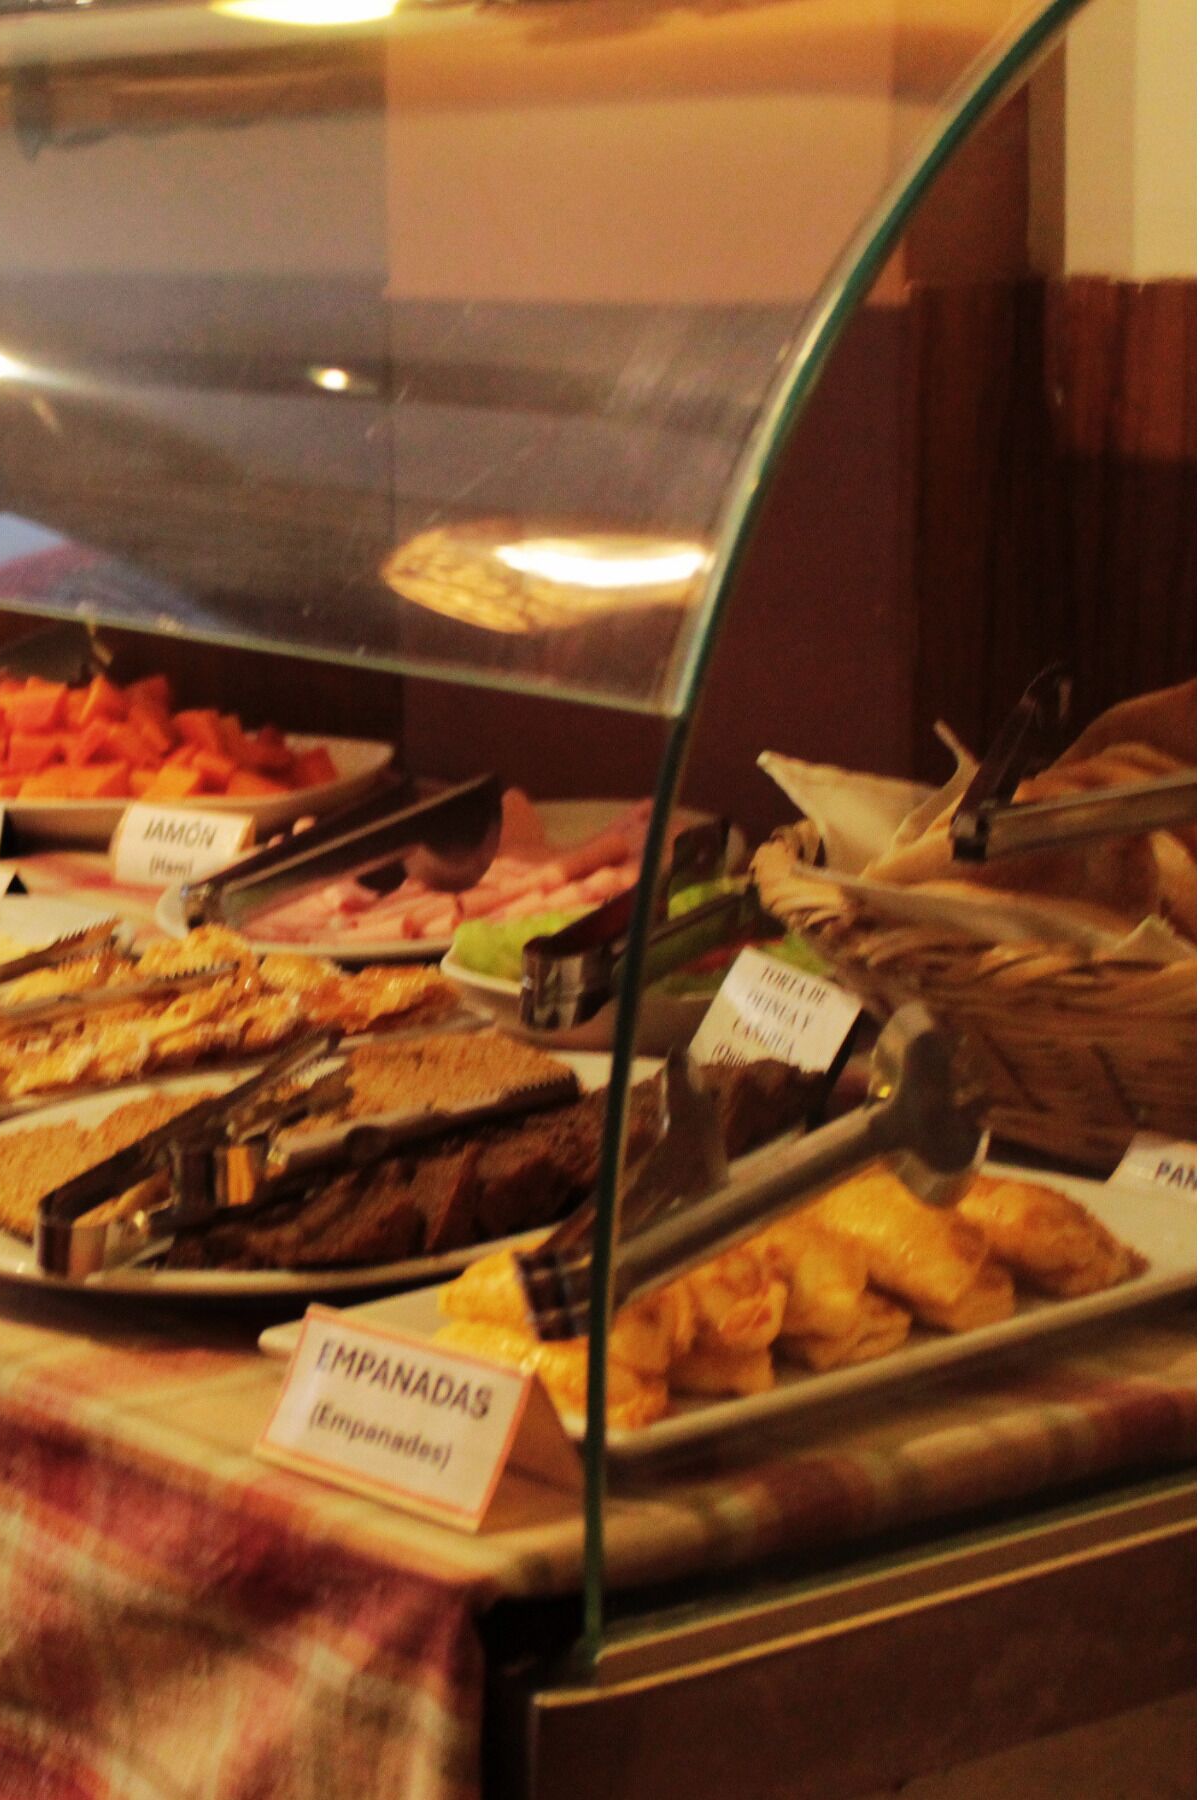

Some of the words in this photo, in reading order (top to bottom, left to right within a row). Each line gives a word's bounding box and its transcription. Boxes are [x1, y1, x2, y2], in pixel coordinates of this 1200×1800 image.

[142, 815, 217, 850] JAMÓN
[314, 1338, 493, 1420] EMPANADAS
[308, 1401, 455, 1472] (Empanades)
